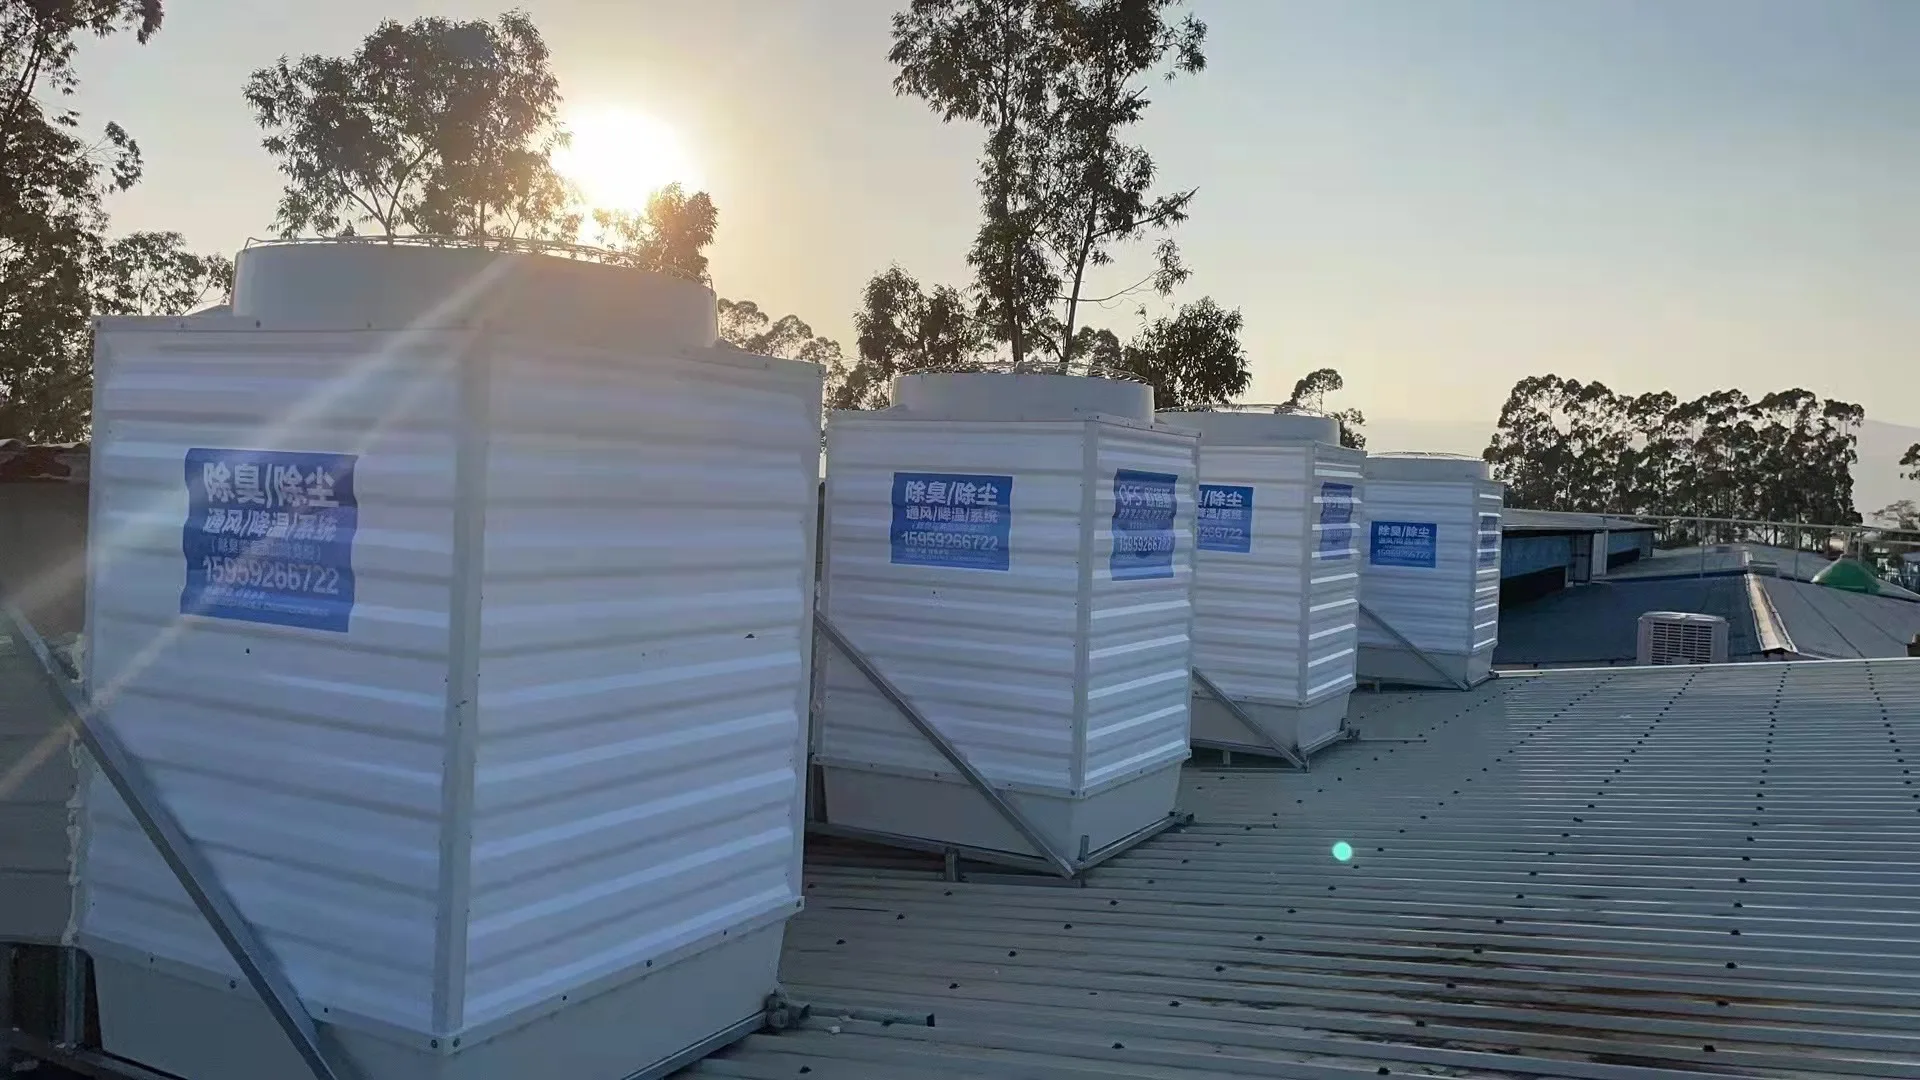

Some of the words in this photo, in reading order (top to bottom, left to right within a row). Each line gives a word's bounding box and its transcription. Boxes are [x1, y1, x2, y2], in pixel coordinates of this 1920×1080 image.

[203, 461, 340, 508] 除臭/除尘
[904, 480, 998, 506] 除臭/除尘
[901, 530, 998, 551] 15959266722
[203, 555, 340, 594] 15959266722
